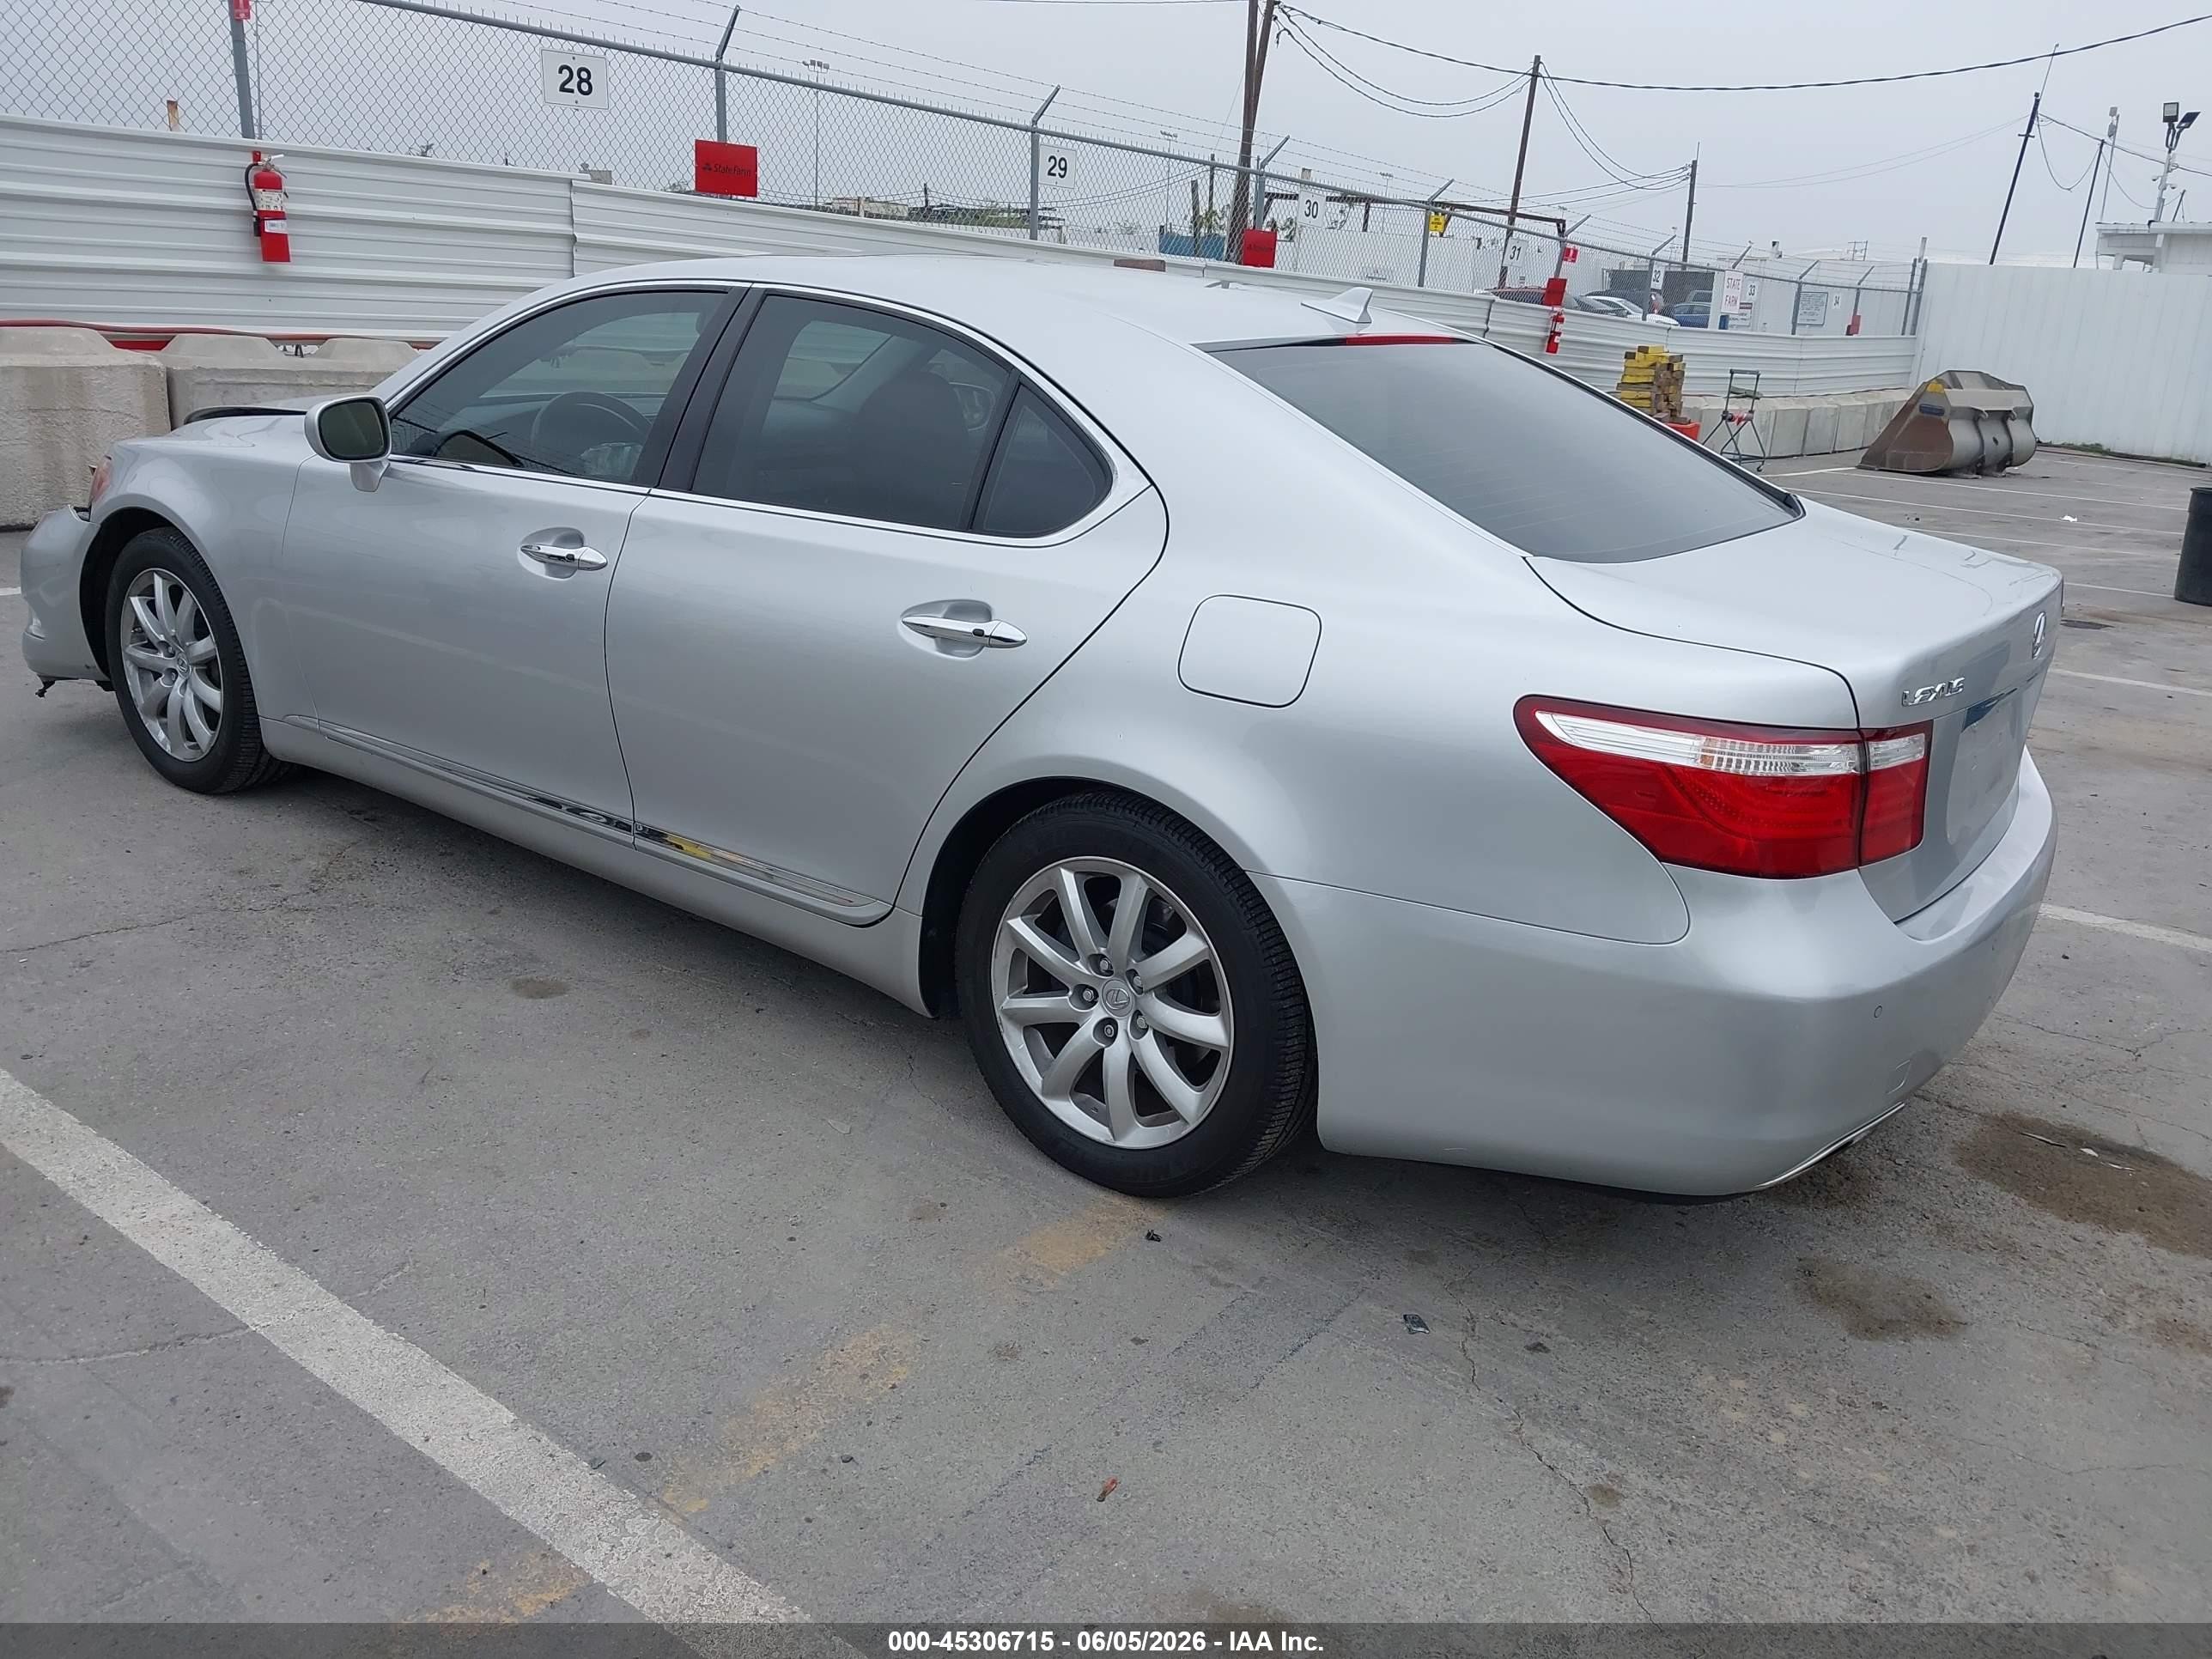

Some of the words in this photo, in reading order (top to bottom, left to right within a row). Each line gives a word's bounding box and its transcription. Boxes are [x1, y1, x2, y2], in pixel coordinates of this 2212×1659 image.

[558, 64, 592, 95] 28
[1048, 155, 1067, 179] 29
[1304, 199, 1319, 219] 30
[1510, 246, 1522, 261] 31
[1652, 269, 1662, 283] 32
[1726, 277, 1741, 290] STATE
[1748, 284, 1756, 296] 33
[1724, 295, 1739, 307] FARM
[1901, 677, 1966, 707] LEXUS
